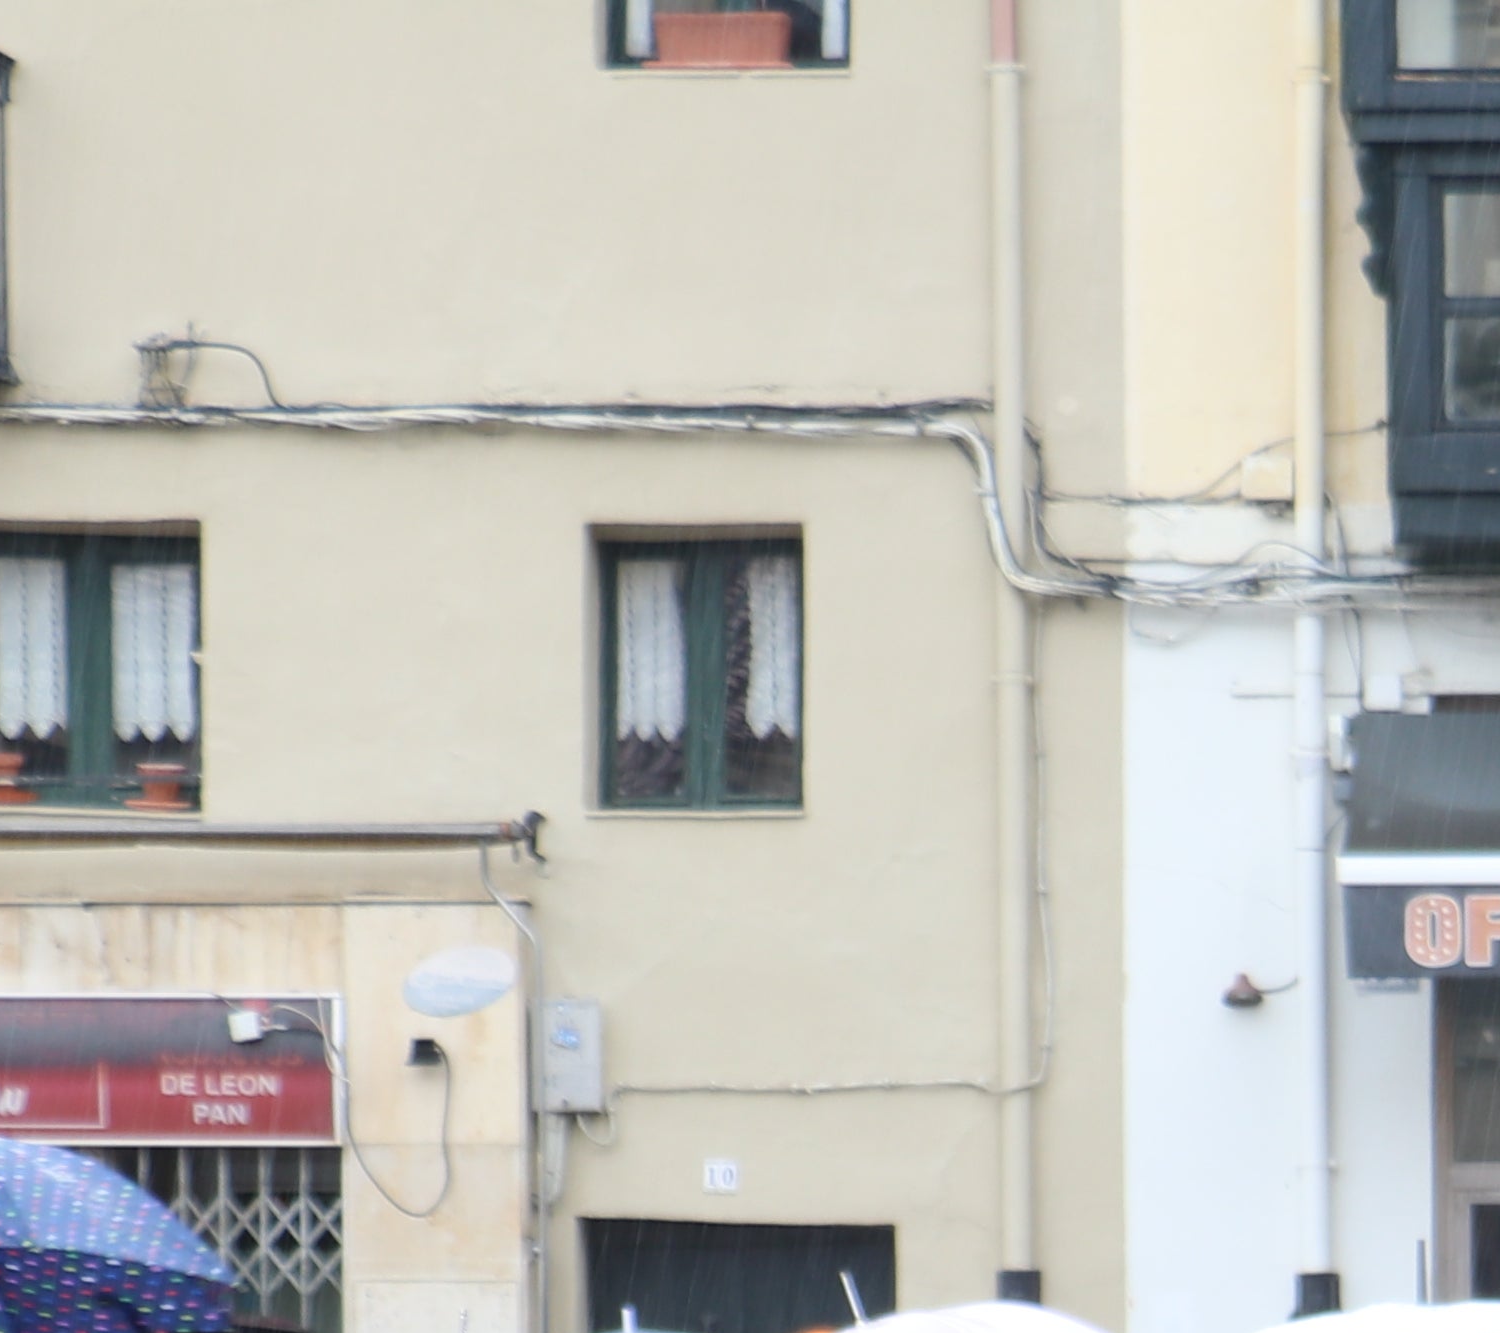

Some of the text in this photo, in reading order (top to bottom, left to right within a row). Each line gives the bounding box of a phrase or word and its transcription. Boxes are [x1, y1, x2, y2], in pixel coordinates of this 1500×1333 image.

[160, 1071, 198, 1097] DE
[191, 1101, 250, 1126] PAN
[707, 1166, 735, 1187] 10
